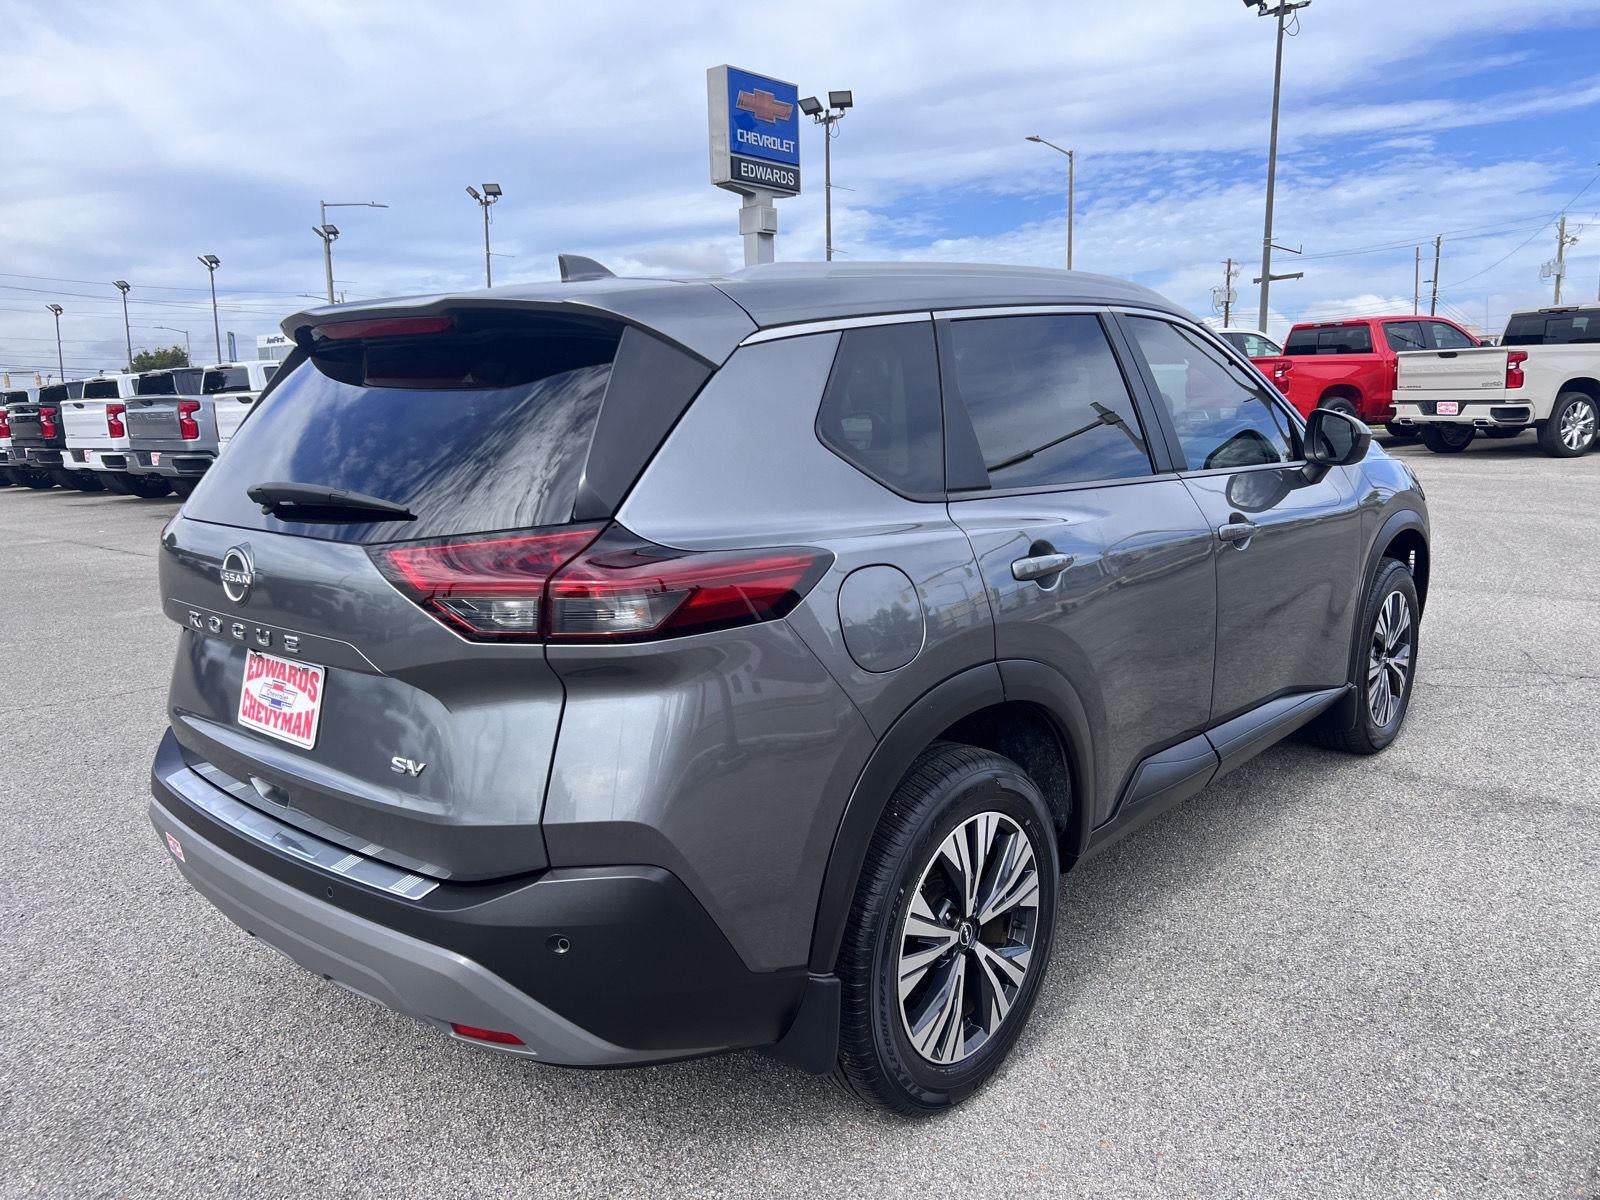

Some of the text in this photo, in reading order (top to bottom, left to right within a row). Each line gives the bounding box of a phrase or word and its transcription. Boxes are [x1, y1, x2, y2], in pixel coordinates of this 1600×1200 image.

[737, 129, 795, 153] CHEVROLET
[740, 162, 795, 186] EDWARDS
[189, 610, 300, 653] ROGUE
[246, 653, 320, 703] EDWARDS
[241, 687, 315, 739] CHEVYMAN
[391, 756, 427, 777] SV
